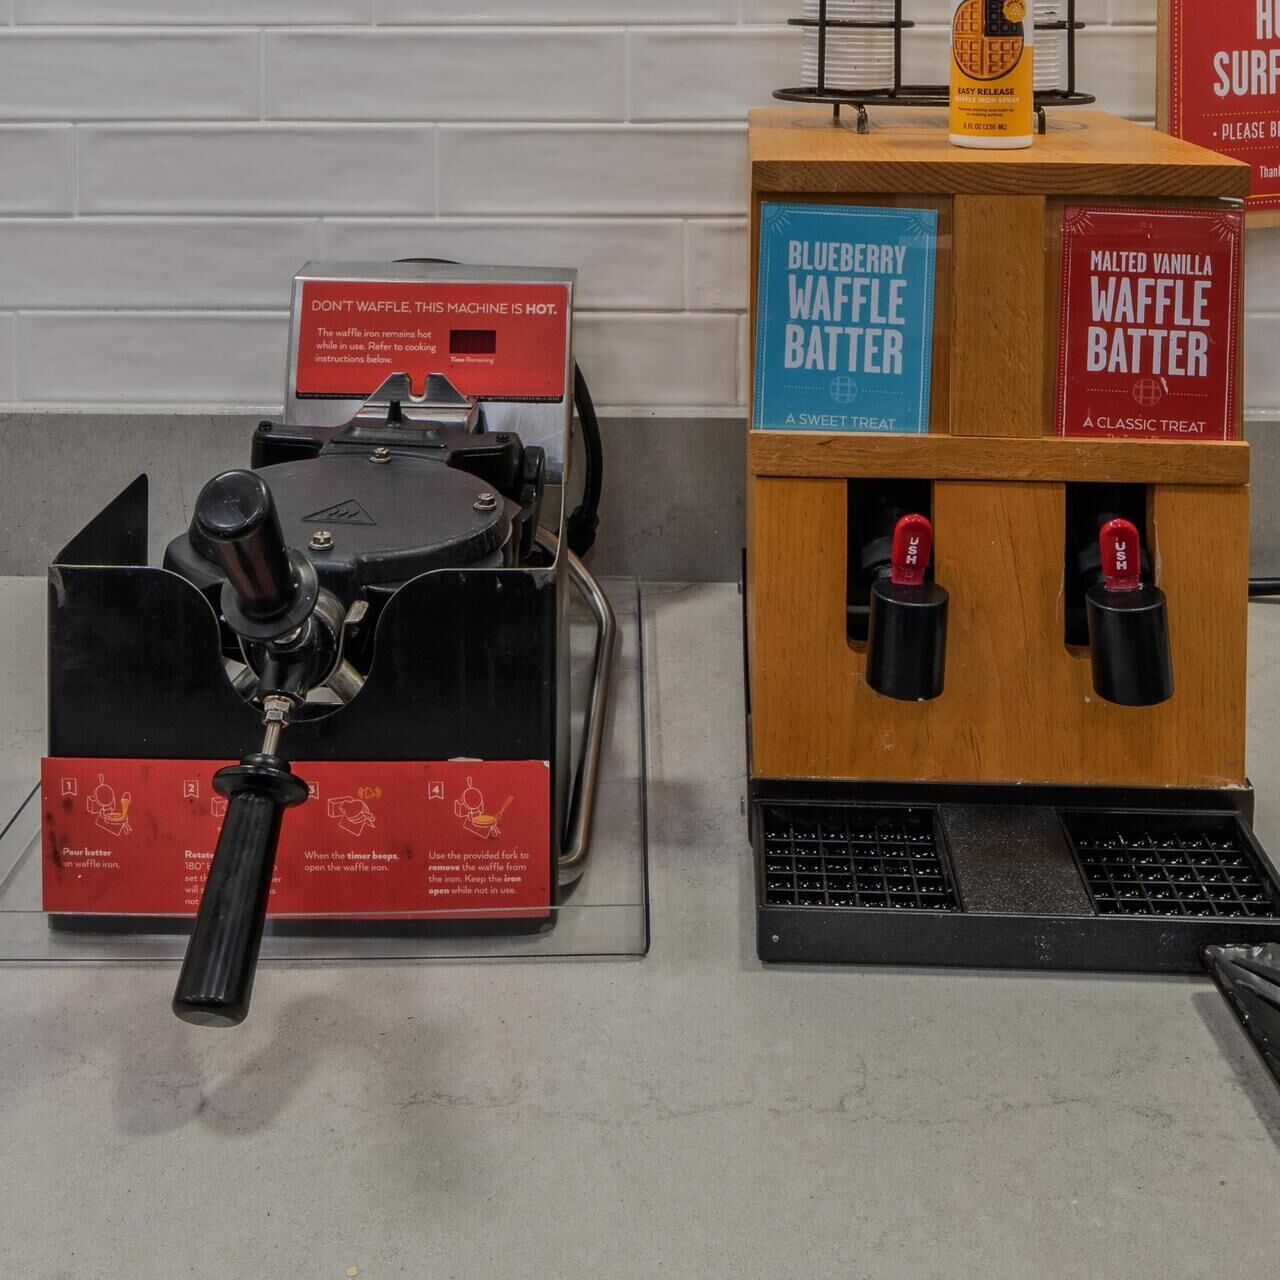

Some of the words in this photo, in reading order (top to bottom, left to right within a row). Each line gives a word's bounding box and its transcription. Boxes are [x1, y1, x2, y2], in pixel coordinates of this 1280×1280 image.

[958, 87, 975, 95] EASY
[977, 87, 1015, 95] RELEASE
[1222, 121, 1265, 141] PLEASE
[788, 240, 907, 274] BLUEBERRY
[1090, 250, 1147, 273] MALTED
[1153, 253, 1212, 276] VANILLA
[788, 274, 907, 325] WAFFLE
[1090, 276, 1212, 327] WAFFLE
[312, 300, 353, 312] DON'T
[356, 301, 412, 314] WAFFLE,
[415, 302, 444, 313] THIS
[447, 303, 508, 314] MACHINE
[511, 304, 522, 314] IS
[526, 304, 557, 314] HOT.
[317, 328, 334, 337] The
[335, 328, 362, 338] waffle
[364, 329, 380, 338] iron
[382, 329, 415, 338] remains
[417, 329, 432, 339] hot
[316, 342, 338, 351] while
[349, 343, 366, 351] use.
[368, 342, 392, 351] Refer
[394, 343, 403, 351] to
[405, 342, 436, 353] cooking
[784, 324, 904, 375] BATTER
[1086, 326, 1208, 377] BATTER
[315, 354, 364, 363] instructions
[367, 354, 392, 364] below.
[785, 413, 795, 424] A
[799, 413, 847, 427] SWEET
[851, 417, 896, 430] TREAT
[1083, 417, 1094, 428] A
[1097, 416, 1157, 432] CLASSIC
[1160, 421, 1206, 433] TREAT
[188, 784, 195, 792] 2
[432, 786, 440, 794] 4
[63, 847, 83, 857] Pour
[85, 848, 112, 857] batter
[304, 851, 329, 860] When
[331, 851, 345, 860] the
[347, 851, 370, 860] timer
[429, 851, 445, 860] Use
[447, 851, 462, 860] the
[463, 851, 499, 862] provided
[501, 851, 518, 860] fork
[74, 859, 101, 868] waffle
[102, 860, 121, 868] iron.
[304, 865, 326, 873] open
[328, 863, 341, 871] the
[343, 863, 370, 871] waffle
[462, 863, 476, 871] the
[478, 863, 504, 871] waffle
[506, 863, 527, 871] from
[429, 875, 442, 883] the
[444, 875, 462, 883] iron.
[465, 875, 486, 885] Keep
[488, 875, 502, 883] the
[504, 875, 521, 883] iron
[185, 886, 198, 894] will
[429, 888, 450, 896] open
[451, 886, 472, 894] while
[474, 886, 489, 894] not
[185, 897, 199, 905] not
